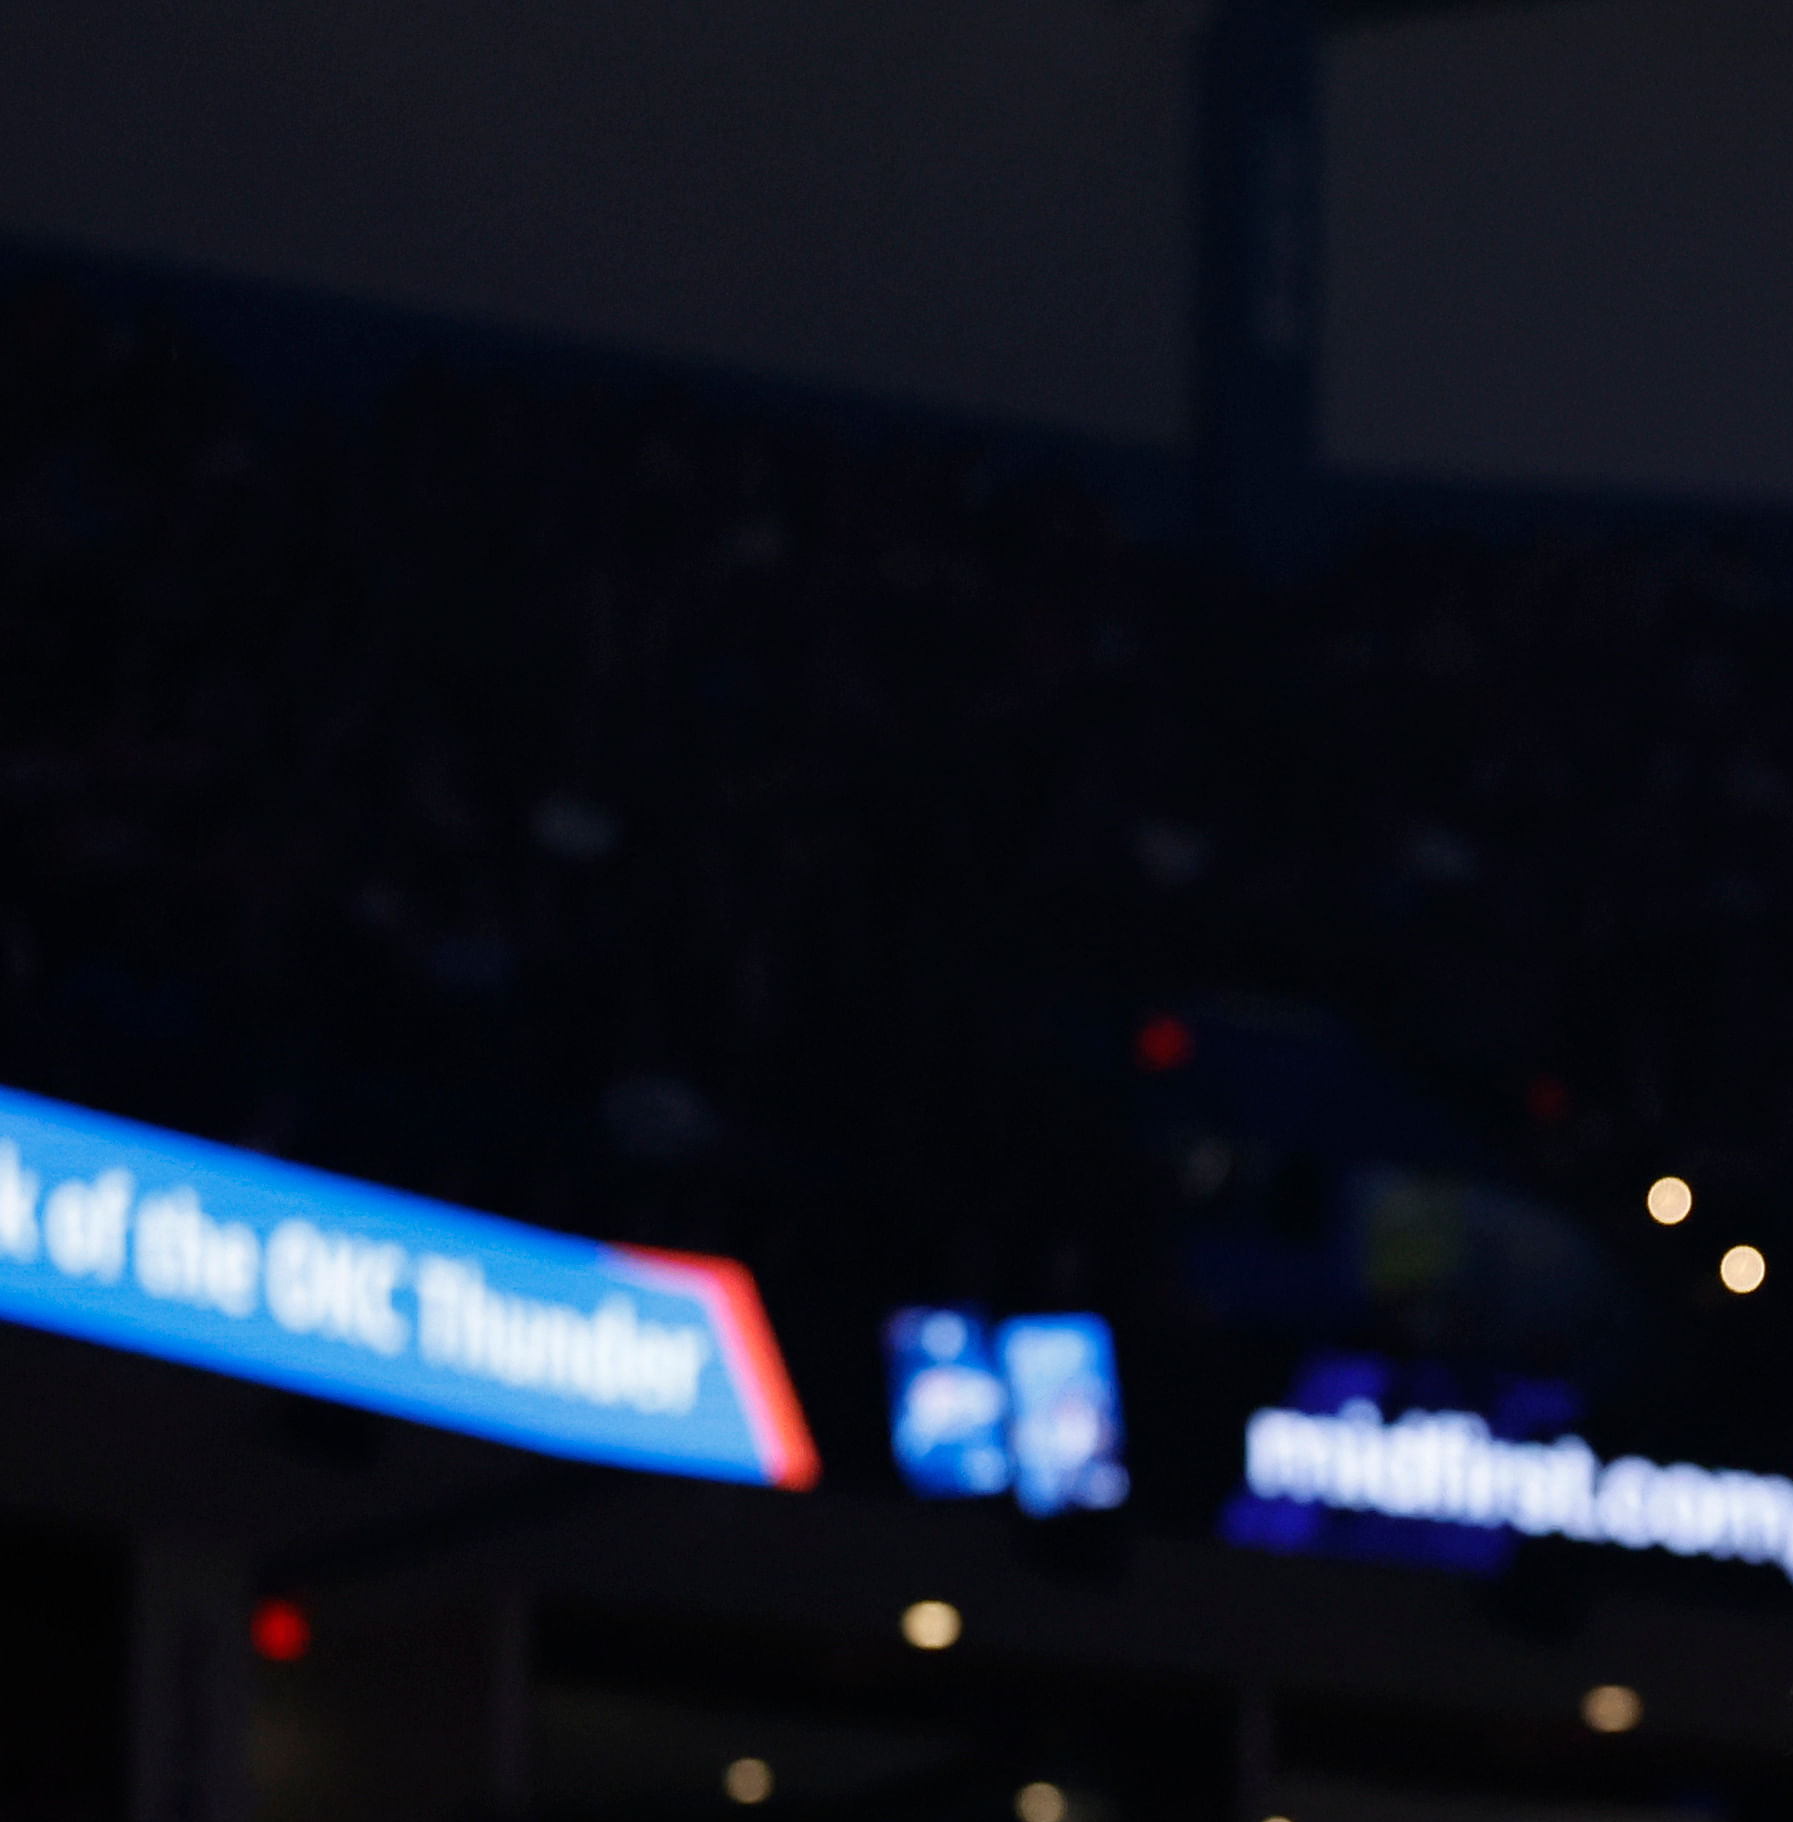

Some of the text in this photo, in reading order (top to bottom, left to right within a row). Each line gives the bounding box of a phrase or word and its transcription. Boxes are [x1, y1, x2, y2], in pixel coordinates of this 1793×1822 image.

[46, 1168, 134, 1283] of
[136, 1186, 260, 1318] the
[266, 1218, 410, 1357] OKC
[416, 1250, 710, 1418] Thunder
